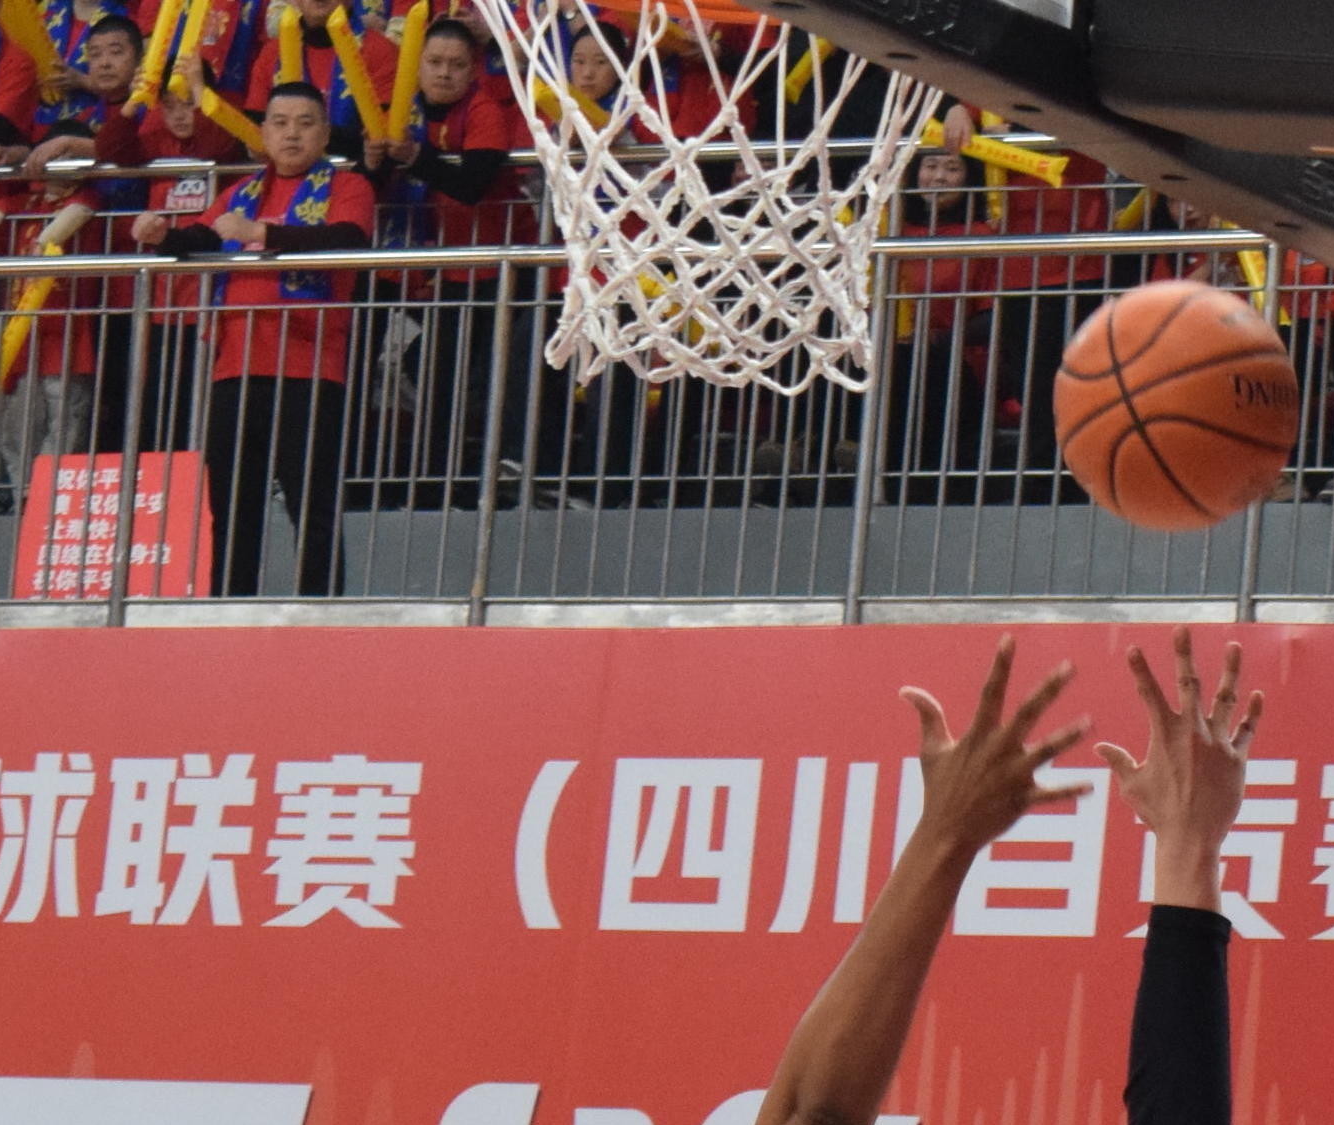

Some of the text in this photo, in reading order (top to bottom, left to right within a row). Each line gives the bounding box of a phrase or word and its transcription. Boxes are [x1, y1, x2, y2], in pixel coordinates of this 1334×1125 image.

[56, 467, 142, 490] 祝你平
[44, 519, 117, 540] 让那快
